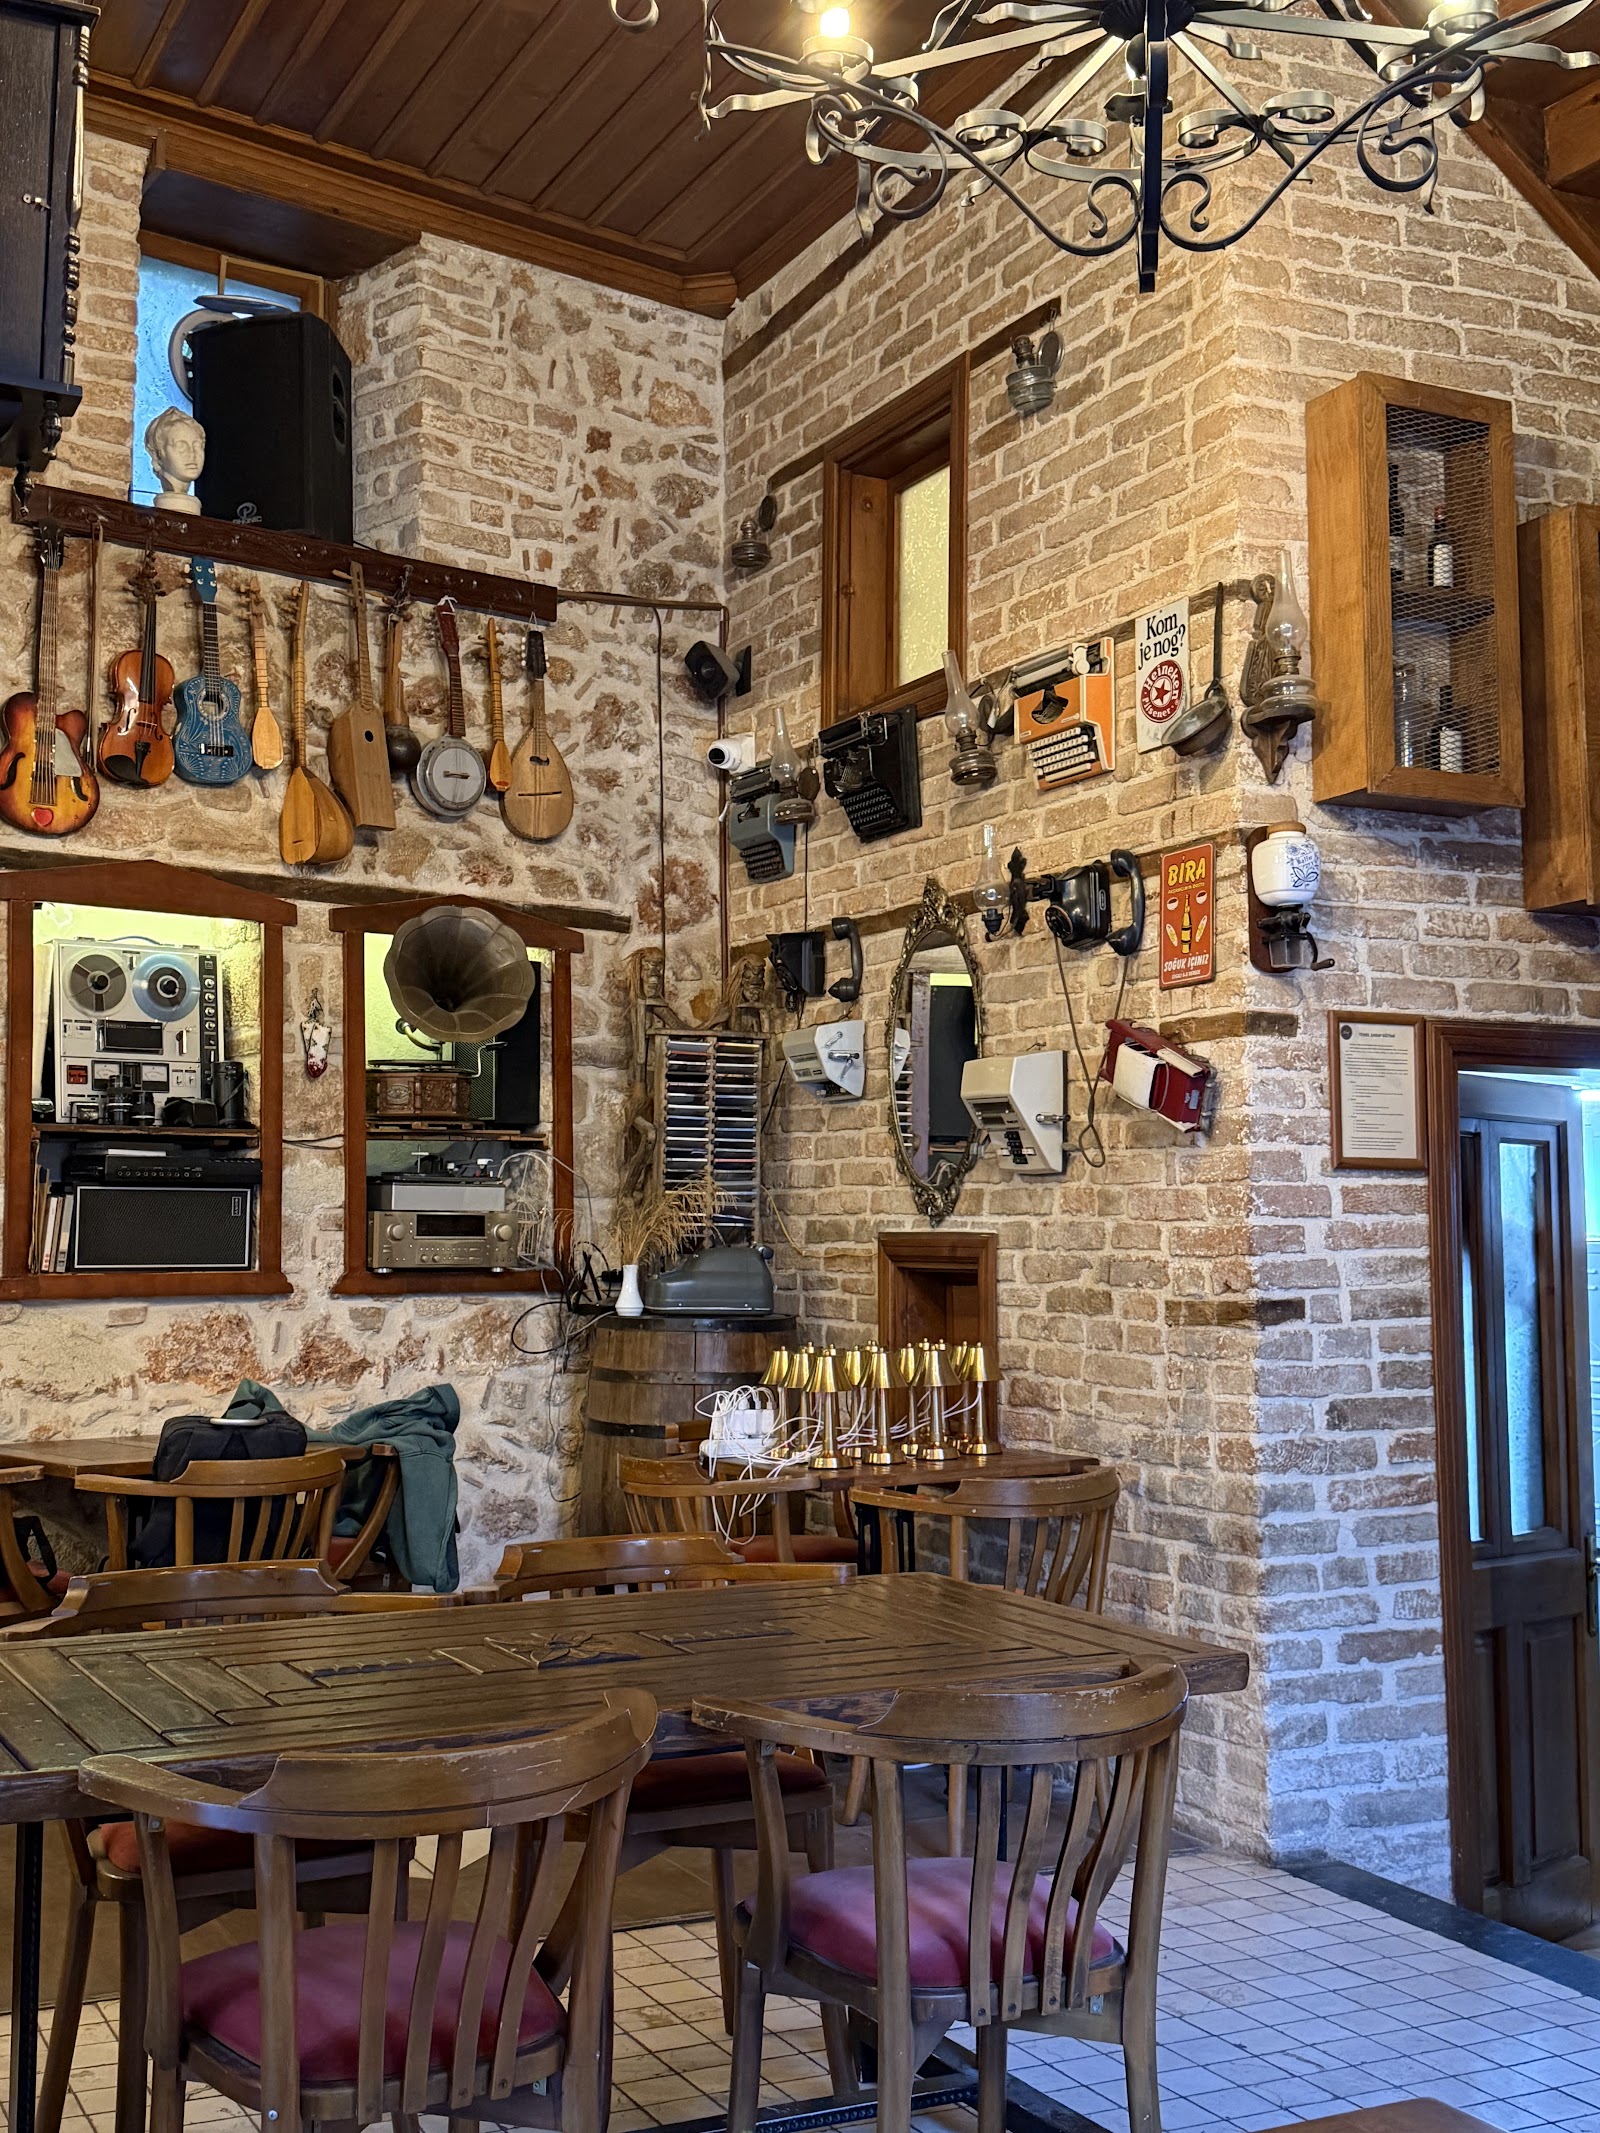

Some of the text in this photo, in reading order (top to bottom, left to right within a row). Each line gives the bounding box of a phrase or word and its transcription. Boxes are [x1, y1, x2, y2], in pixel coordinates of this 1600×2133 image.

[1146, 613, 1178, 640] Kom
[1138, 623, 1186, 670] je nog?
[1143, 664, 1180, 700] Heineken
[1142, 697, 1171, 718] Pilsener
[1167, 855, 1206, 886] BİRA
[1163, 949, 1209, 972] SOĞUK İÇİNİZ
